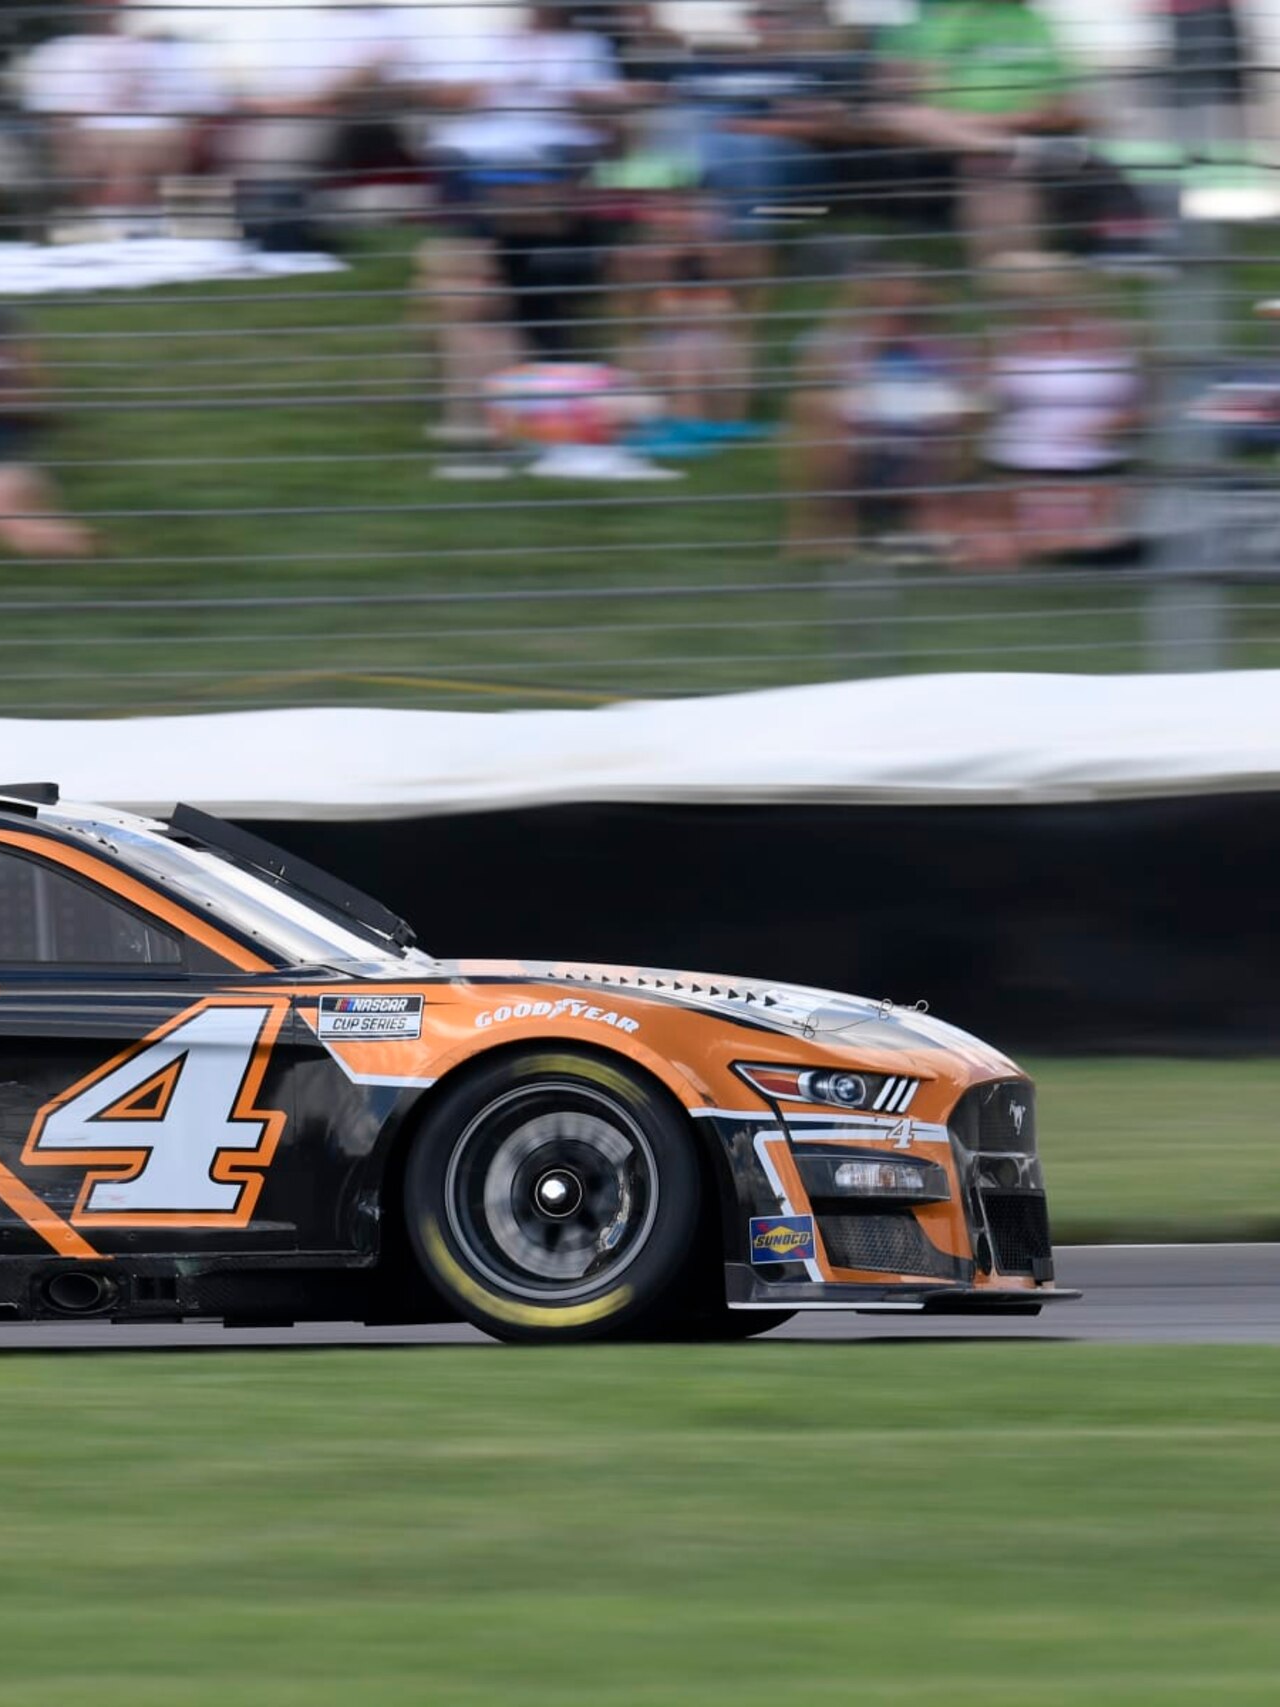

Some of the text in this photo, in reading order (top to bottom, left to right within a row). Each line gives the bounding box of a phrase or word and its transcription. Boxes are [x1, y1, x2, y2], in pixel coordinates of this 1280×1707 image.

[351, 998, 407, 1012] NASCAR
[332, 1016, 407, 1031] CUP SERIES
[29, 1001, 280, 1219] 4
[886, 1119, 915, 1149] 4
[754, 1231, 811, 1247] SUNOCO
